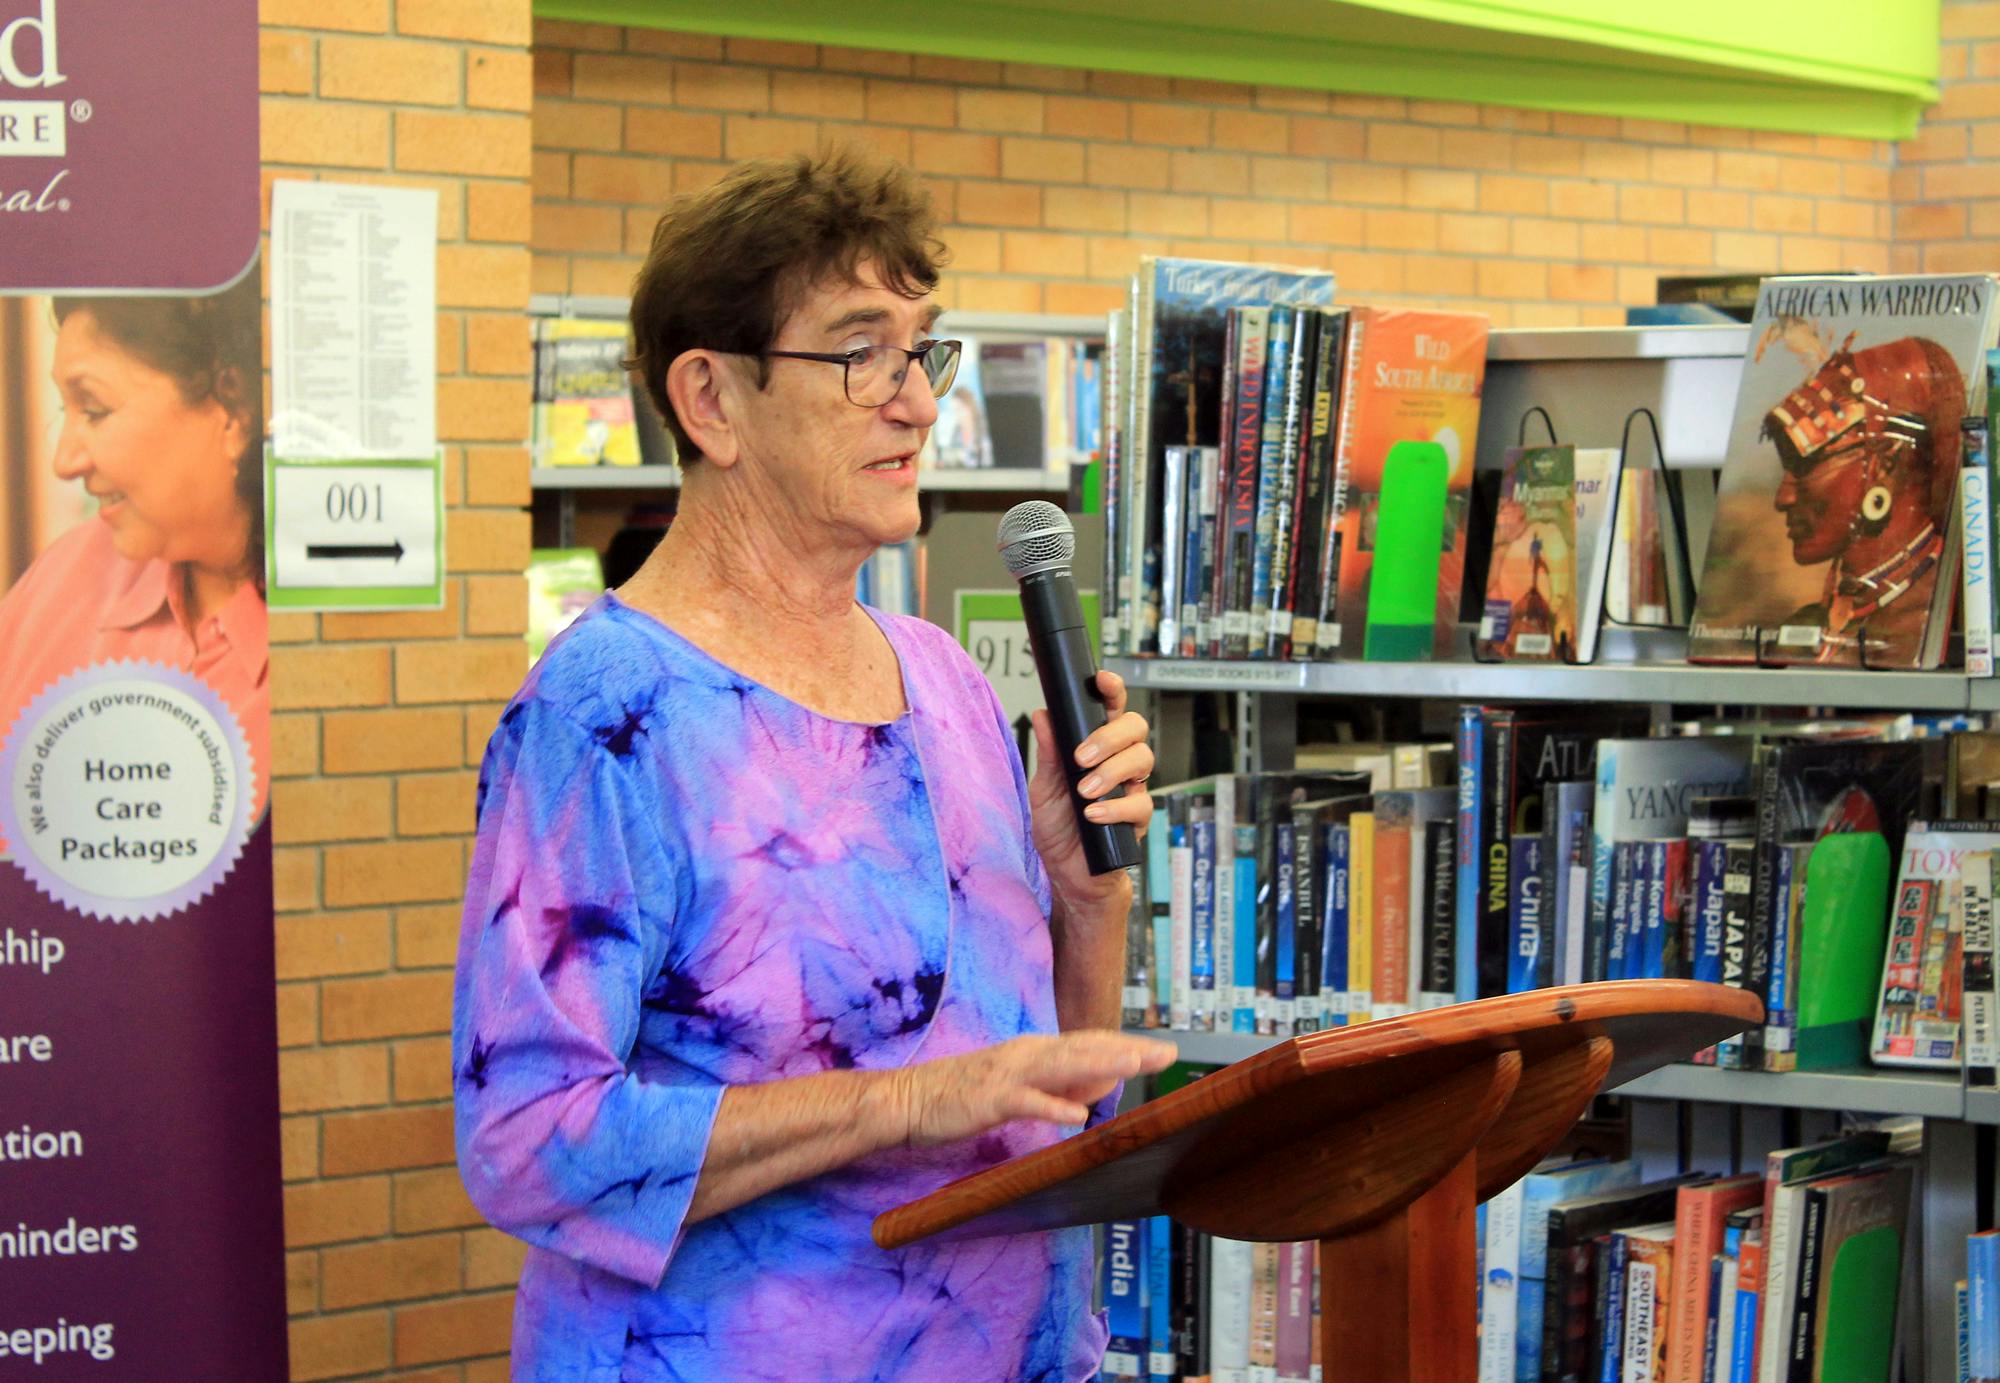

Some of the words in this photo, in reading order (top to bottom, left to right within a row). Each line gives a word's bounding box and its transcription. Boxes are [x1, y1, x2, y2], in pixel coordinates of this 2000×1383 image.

[1760, 286, 1850, 318] AFRICAN
[1860, 282, 1984, 317] WARRIORS
[1243, 336, 1261, 398] WILD
[1234, 402, 1258, 527] INDONESIA
[1281, 426, 1298, 461] THE
[326, 482, 382, 523] 001
[1277, 463, 1295, 501] LIFE
[1964, 474, 1985, 587] CANADA
[1270, 529, 1289, 589] AFRICA
[36, 708, 84, 759] deliver
[89, 694, 201, 730] government
[25, 763, 44, 799] also
[85, 760, 171, 781] Home
[196, 730, 228, 826] subsidised
[1459, 766, 1475, 811] ASIA
[30, 805, 49, 835] We
[96, 798, 162, 820] Care
[61, 835, 198, 864] Packages
[1195, 857, 1210, 906] Greek
[1296, 834, 1313, 928] ISTANBUL
[1335, 868, 1346, 909] Croatia
[1434, 836, 1451, 917] MARCO
[1489, 843, 1508, 913] CHINA
[1519, 875, 1541, 958] China
[1612, 882, 1627, 919] Hong
[1647, 880, 1664, 929] Korea
[1702, 880, 1724, 957] Japan
[1193, 909, 1210, 967] Islands
[1608, 923, 1627, 960] Kong
[1964, 902, 1979, 947] BRAZIL
[1978, 909, 1991, 948] DEATH
[1434, 922, 1450, 986] POLO
[0, 1125, 82, 1161] tion
[1690, 1200, 1703, 1246] WHERE
[1112, 1223, 1136, 1297] India
[1687, 1251, 1699, 1293] CHINA
[1635, 1270, 1652, 1366] SOUTHEAST
[1684, 1298, 1697, 1341] MEETS
[1680, 1344, 1692, 1382] INDIA
